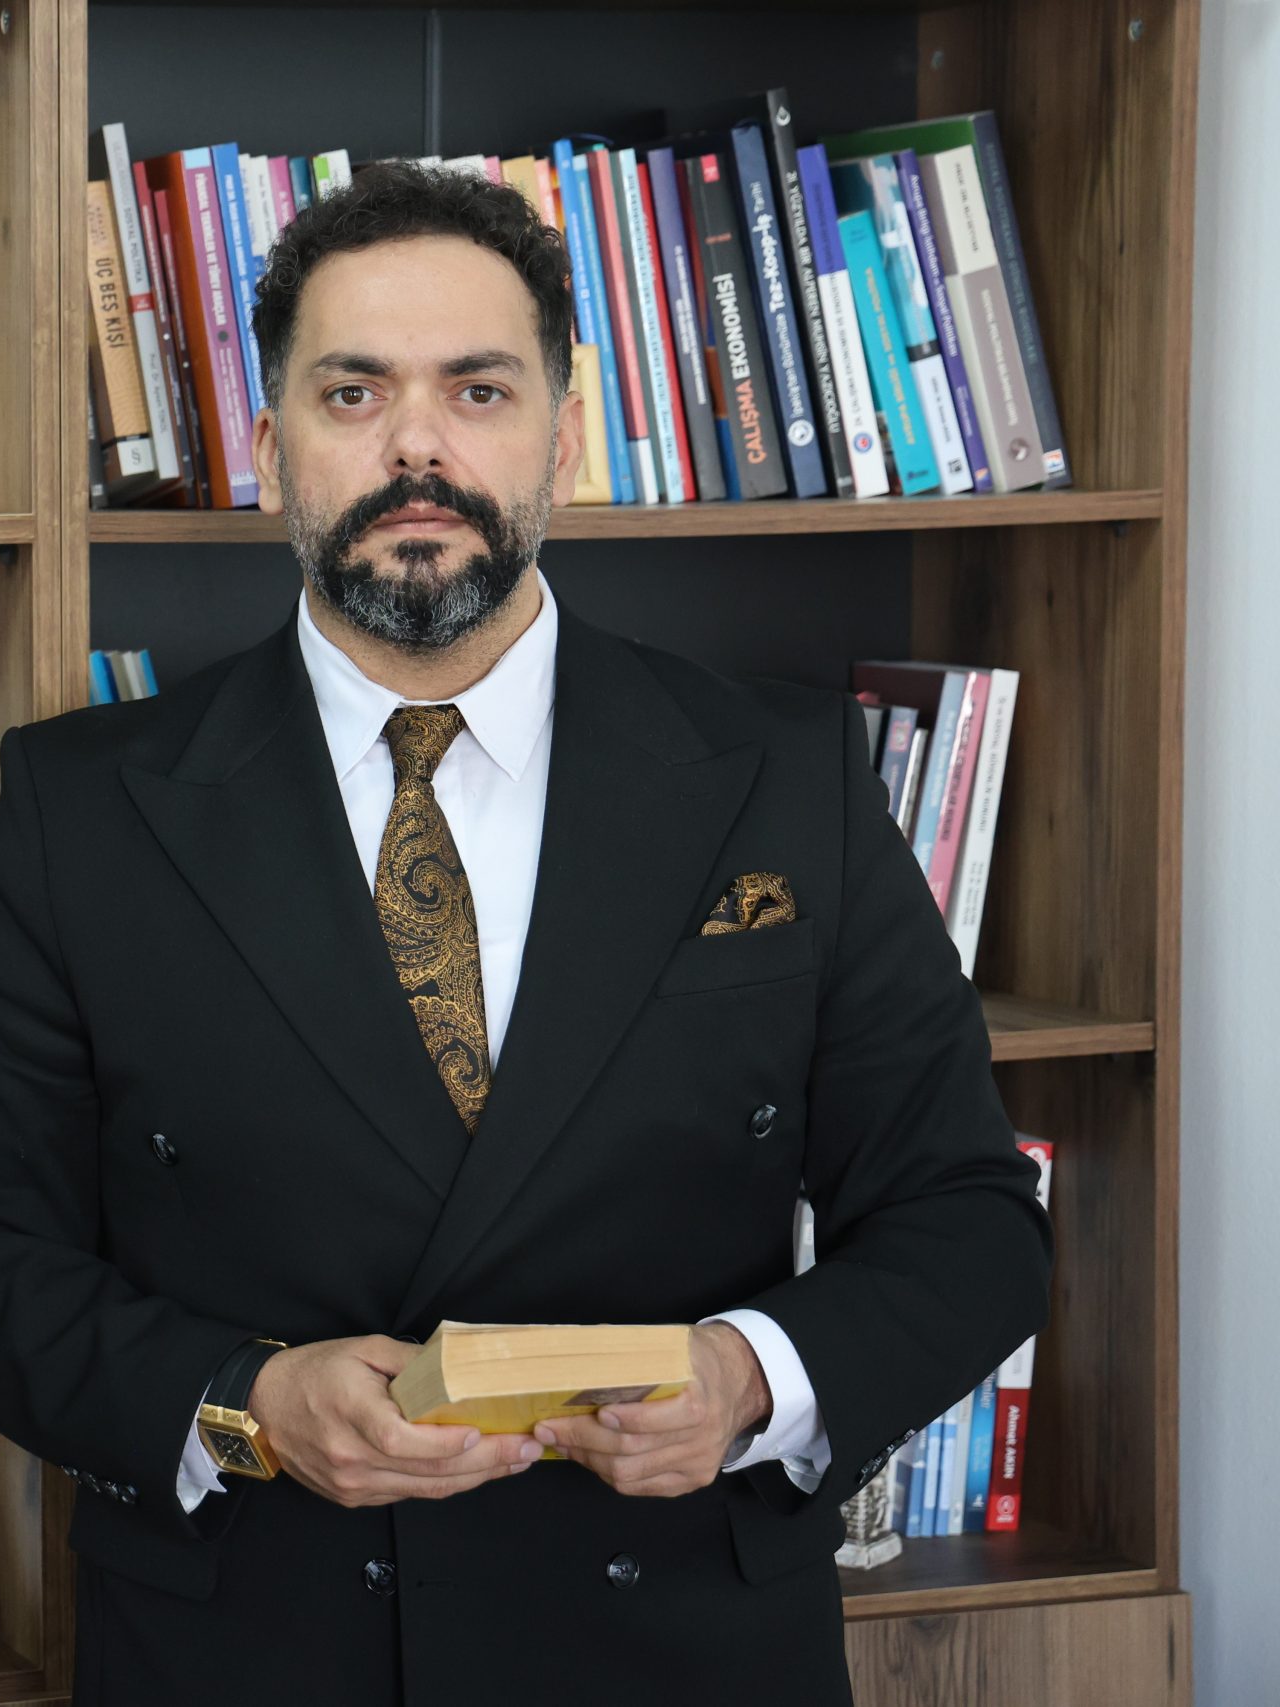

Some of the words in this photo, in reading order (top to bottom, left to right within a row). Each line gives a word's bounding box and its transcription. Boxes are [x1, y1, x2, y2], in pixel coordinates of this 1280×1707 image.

[95, 258, 114, 278] ÜÇ
[99, 283, 118, 312] BEŞ
[104, 318, 127, 349] KİŞİ
[713, 272, 751, 379] EKONOMİSİ
[736, 380, 767, 464] ÇALIŞMA
